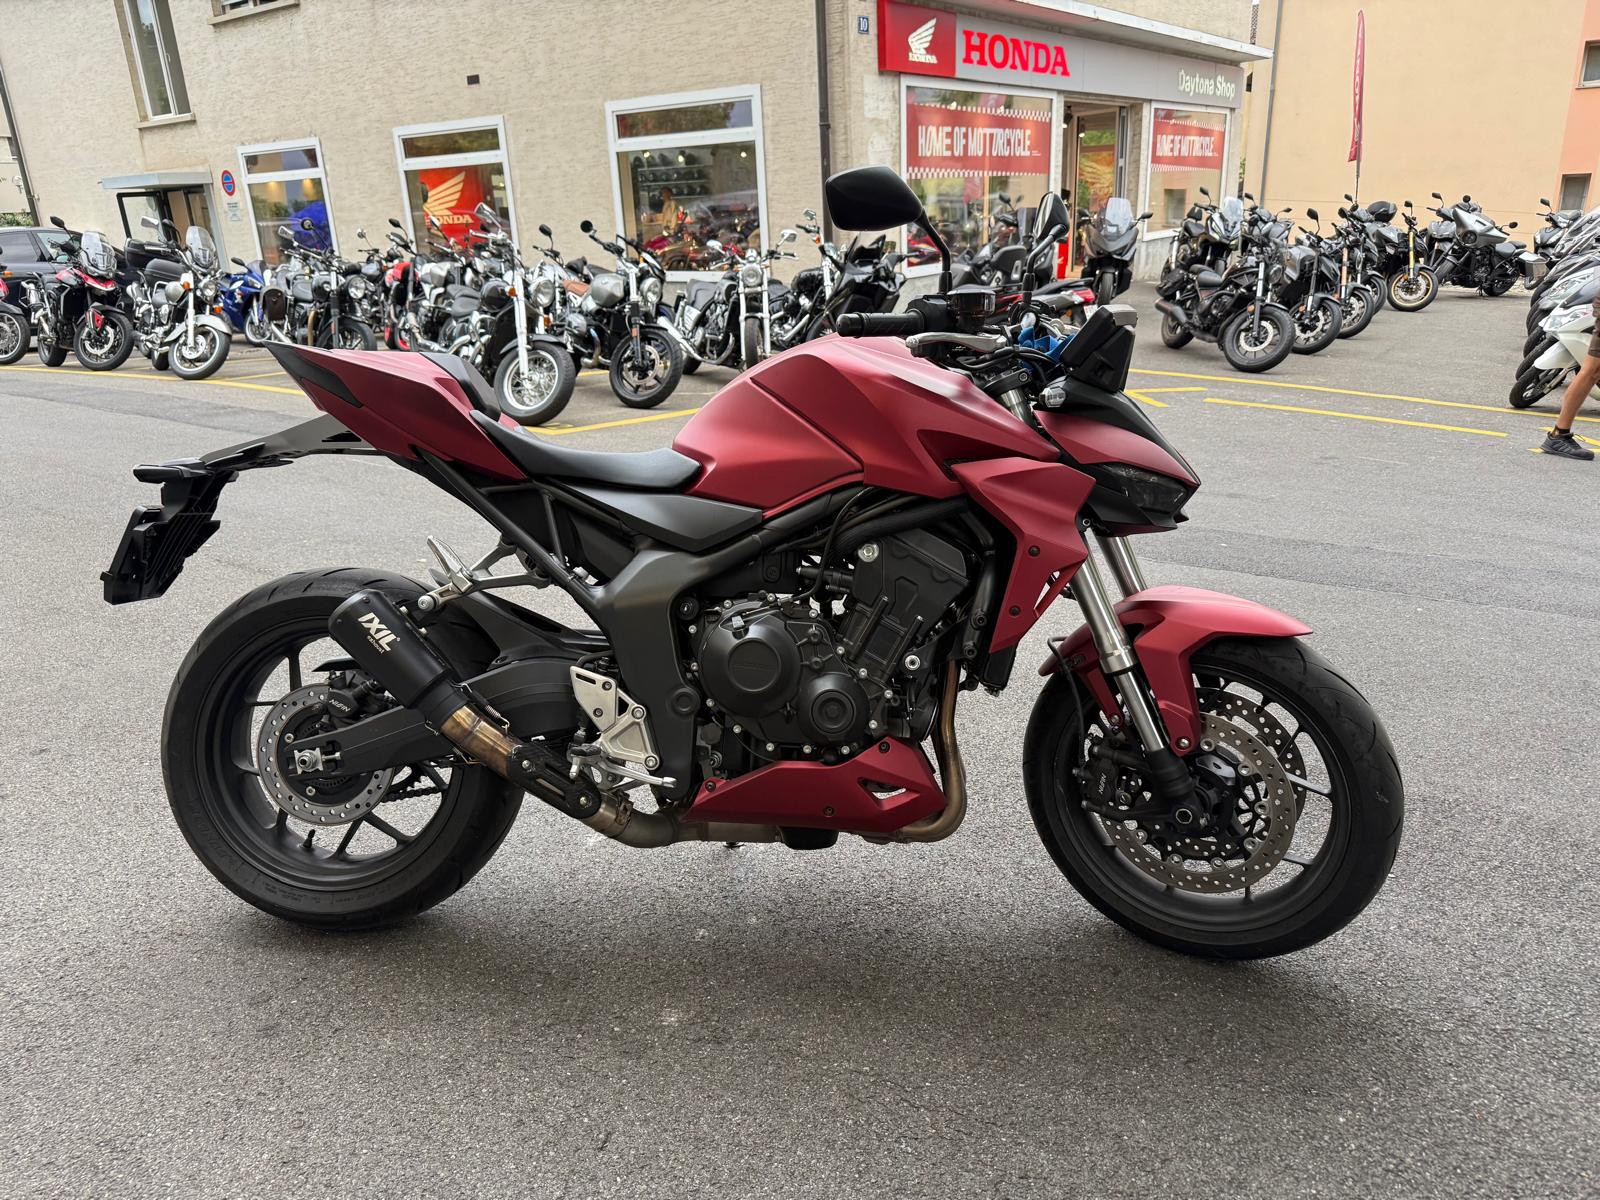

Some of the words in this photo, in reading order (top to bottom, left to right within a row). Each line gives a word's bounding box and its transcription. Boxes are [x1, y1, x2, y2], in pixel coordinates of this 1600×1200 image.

[962, 30, 1070, 77] HONDA
[1179, 69, 1214, 96] Daytona
[1216, 75, 1235, 100] Shop
[953, 126, 966, 157] OF
[357, 612, 397, 652] IXIL
